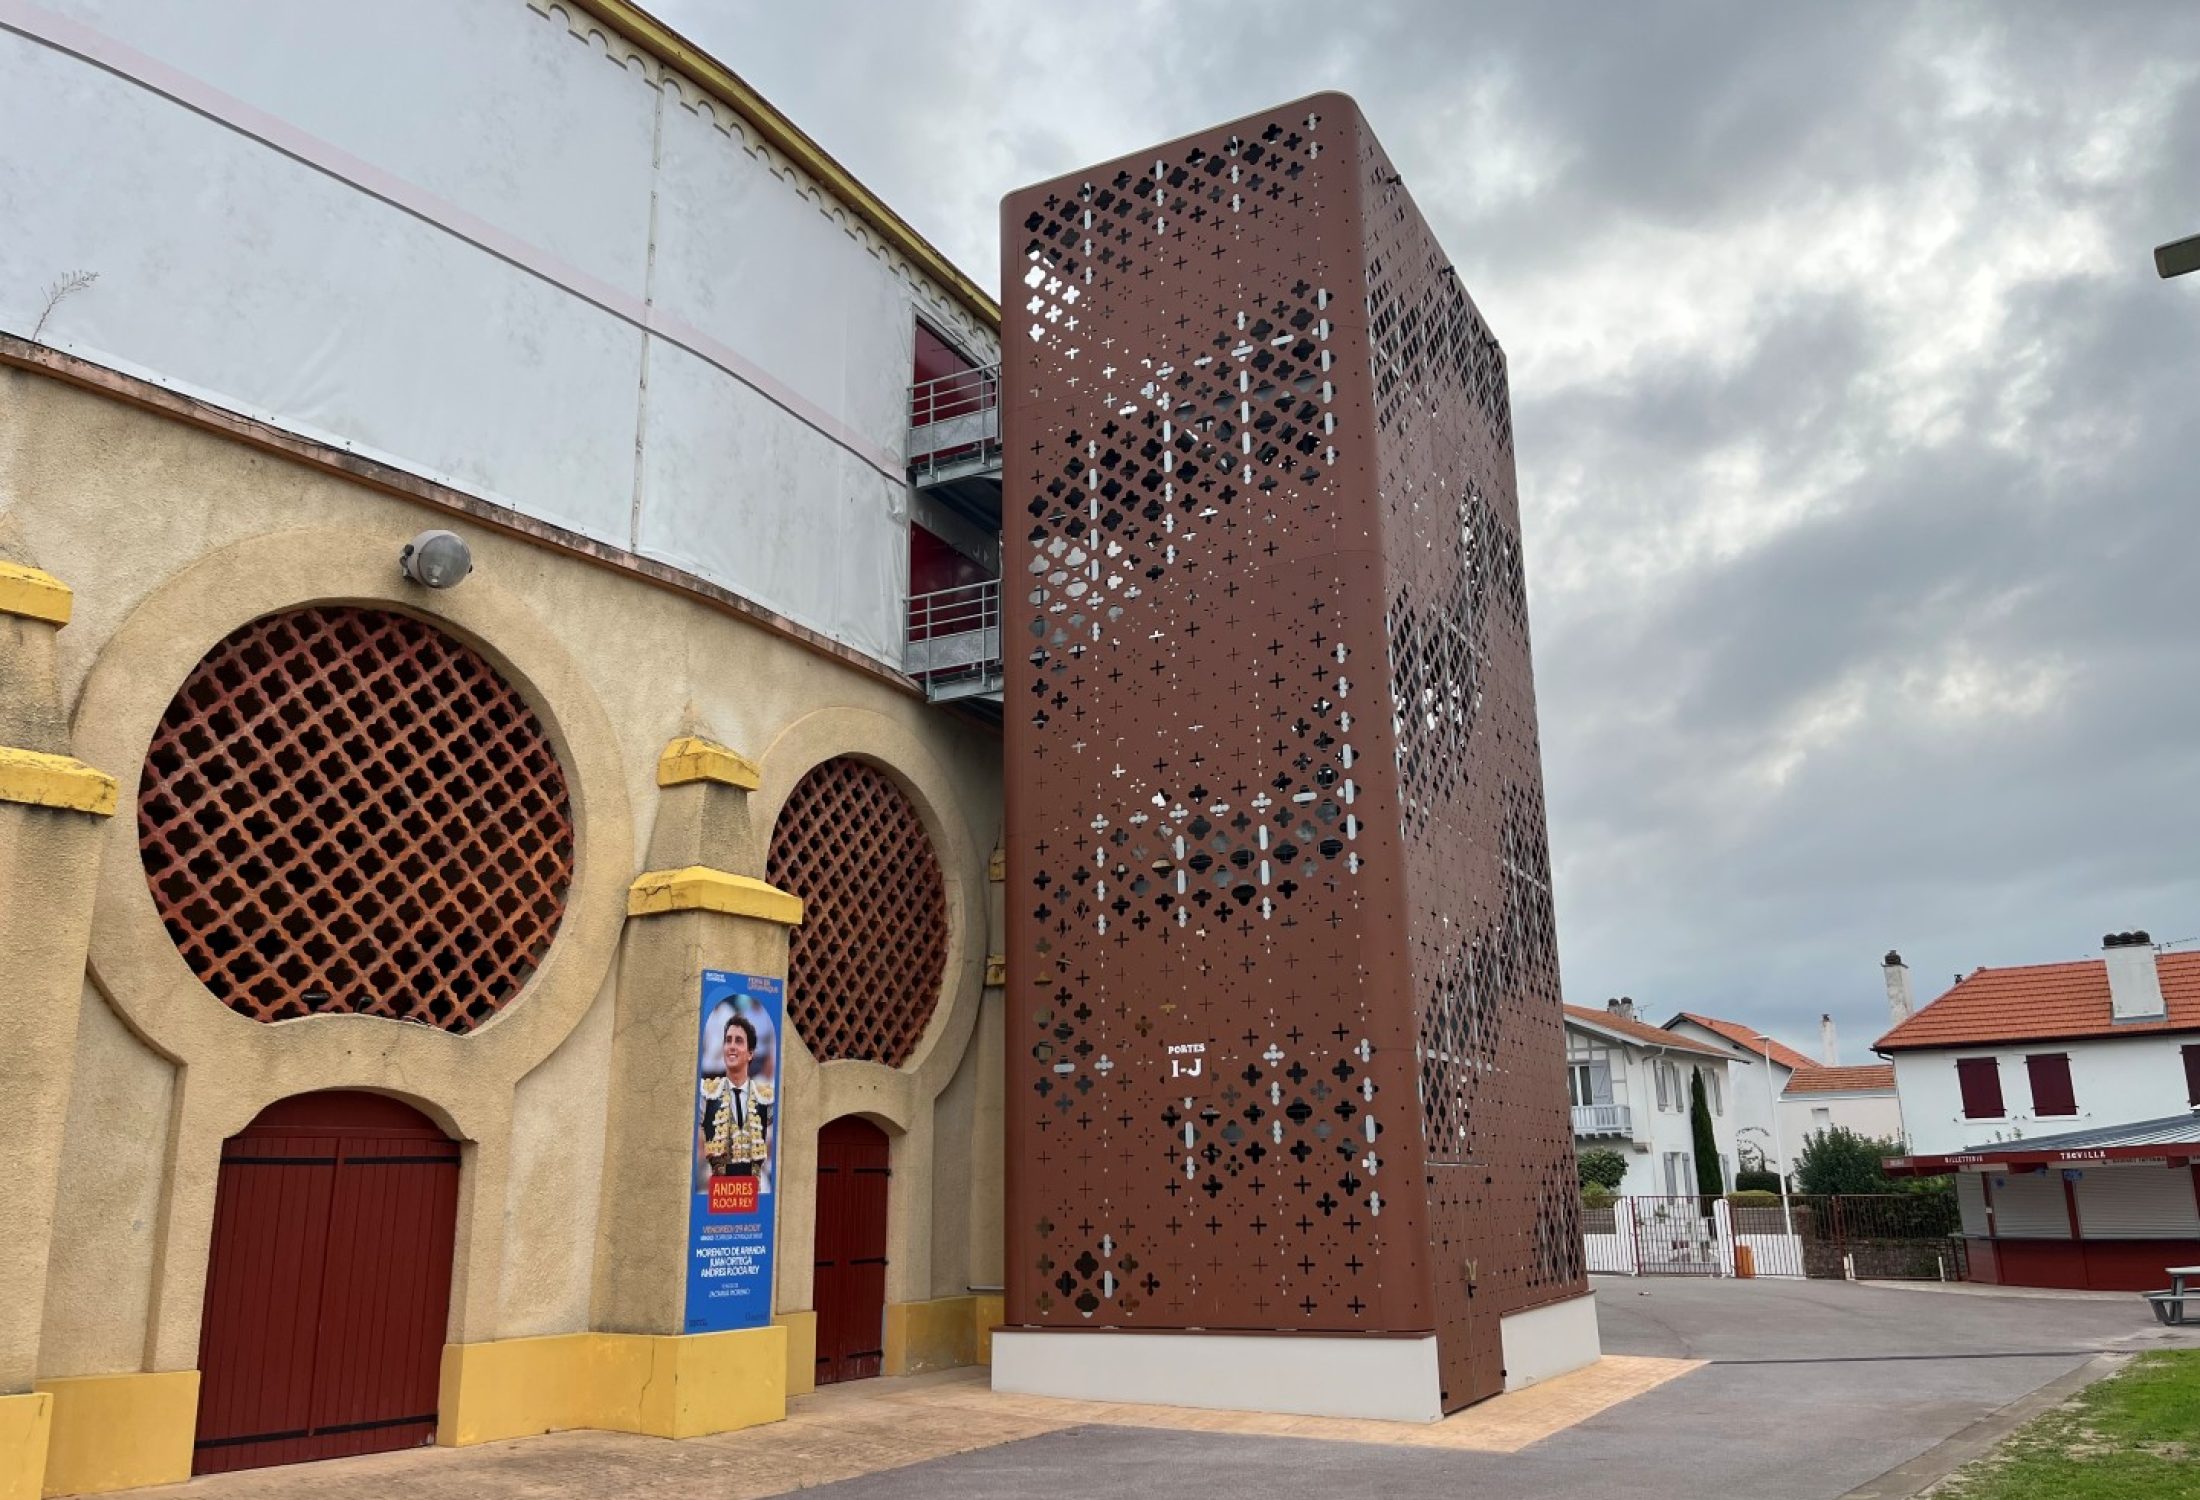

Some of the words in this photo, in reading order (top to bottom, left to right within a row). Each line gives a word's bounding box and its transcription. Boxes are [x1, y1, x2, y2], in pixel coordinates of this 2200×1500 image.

[1168, 1043, 1205, 1054] PORTES
[1172, 1058, 1202, 1077] I-J
[713, 1183, 753, 1196] ANDRES
[713, 1198, 737, 1208] ROCA
[740, 1198, 753, 1207] REY
